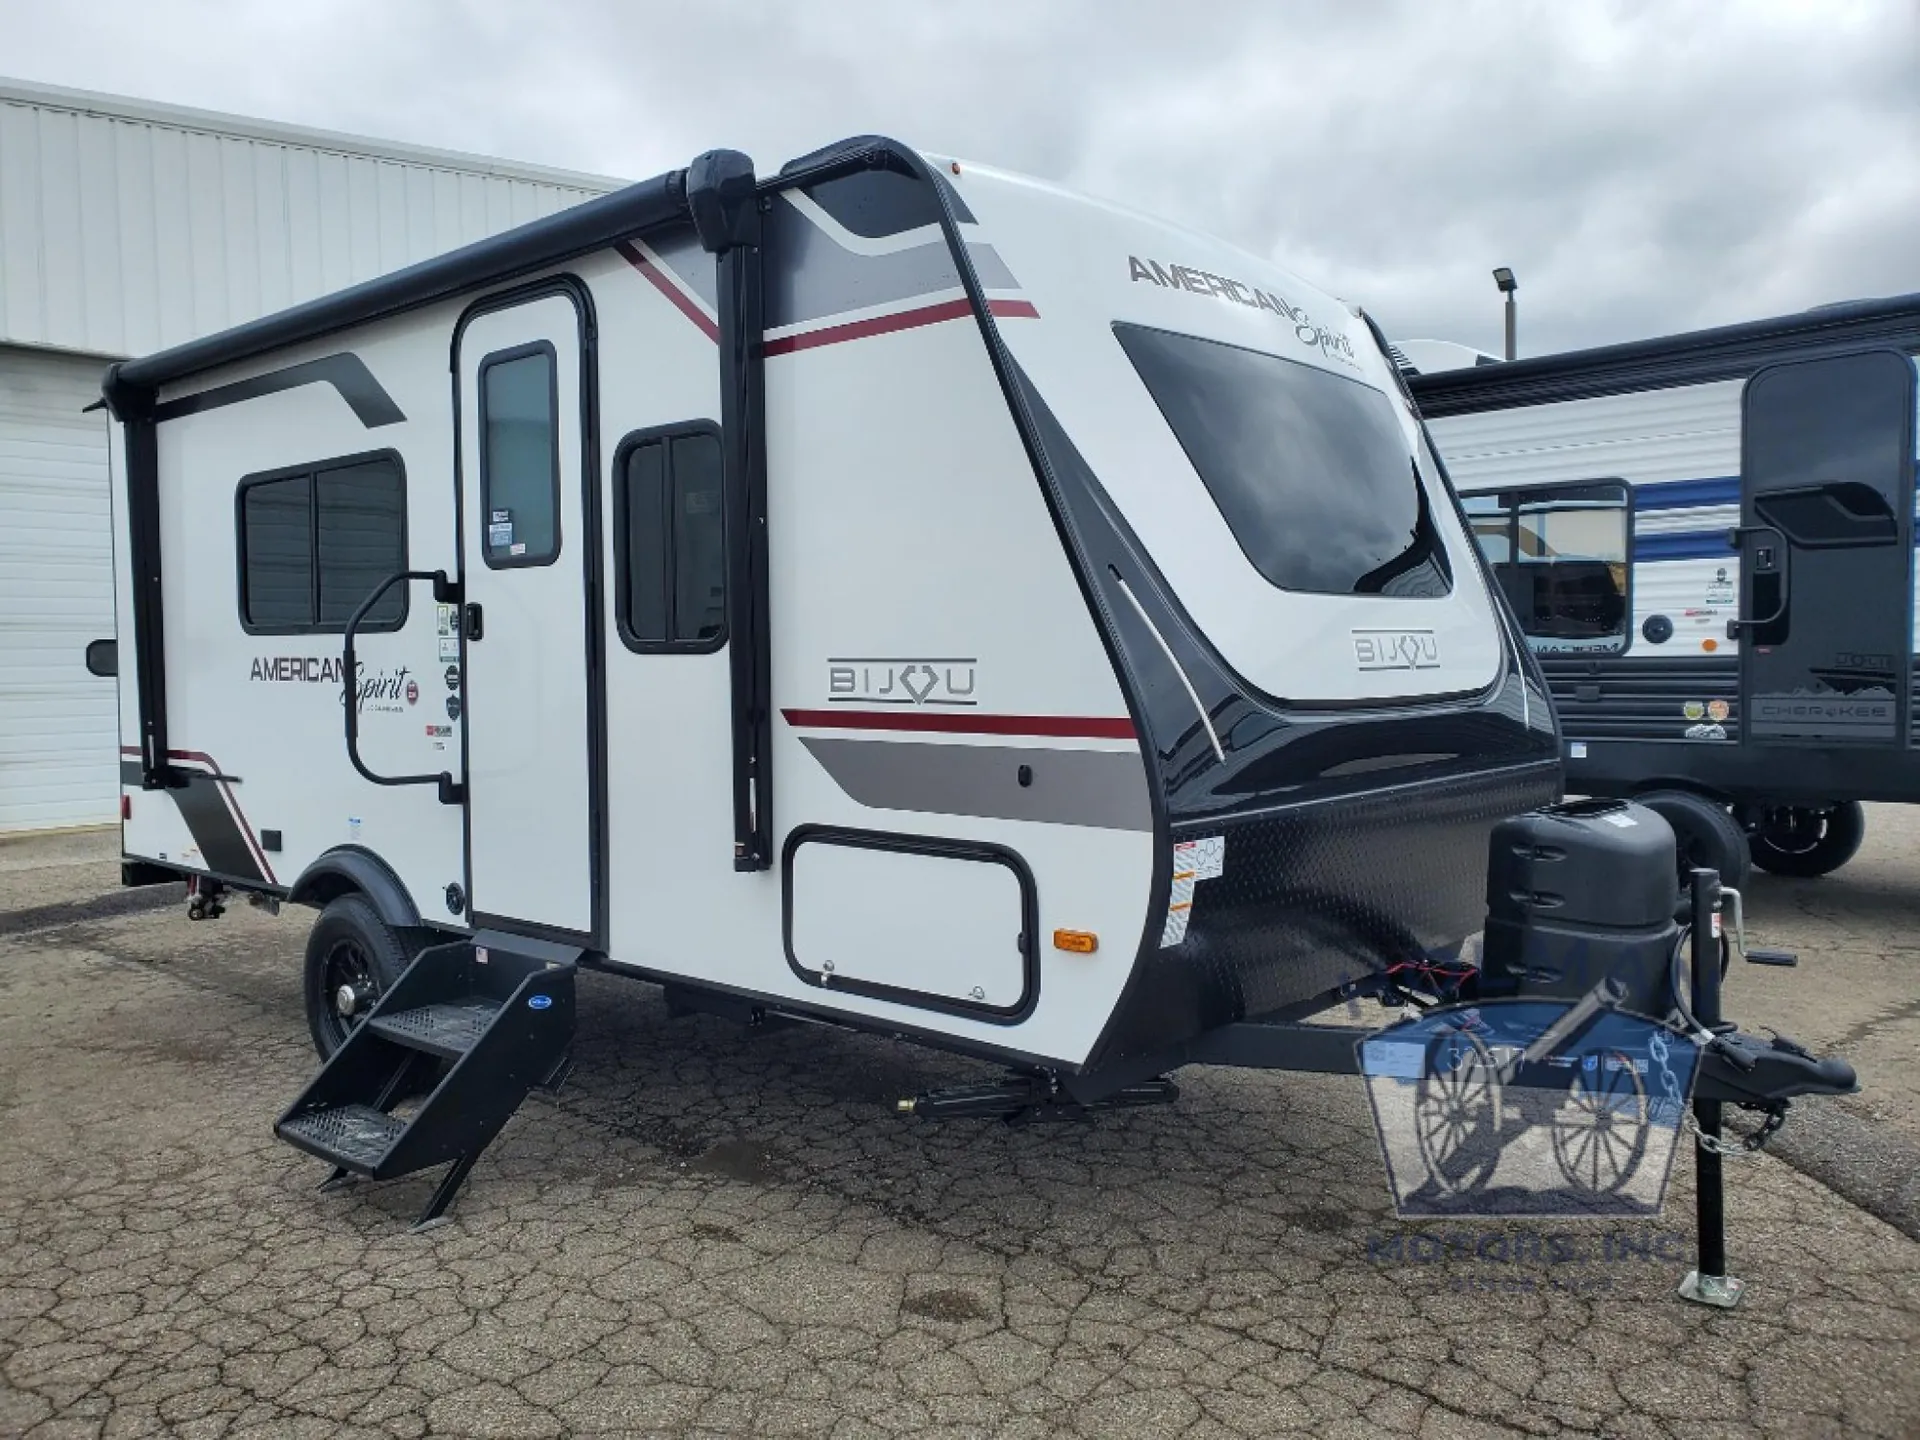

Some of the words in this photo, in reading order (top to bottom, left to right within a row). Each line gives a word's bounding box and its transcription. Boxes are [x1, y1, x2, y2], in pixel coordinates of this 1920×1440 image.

[1128, 255, 1299, 322] AMERICAN
[1293, 307, 1354, 358] Spirit
[1355, 635, 1437, 670] BIJOU
[830, 665, 974, 705] BIJOU
